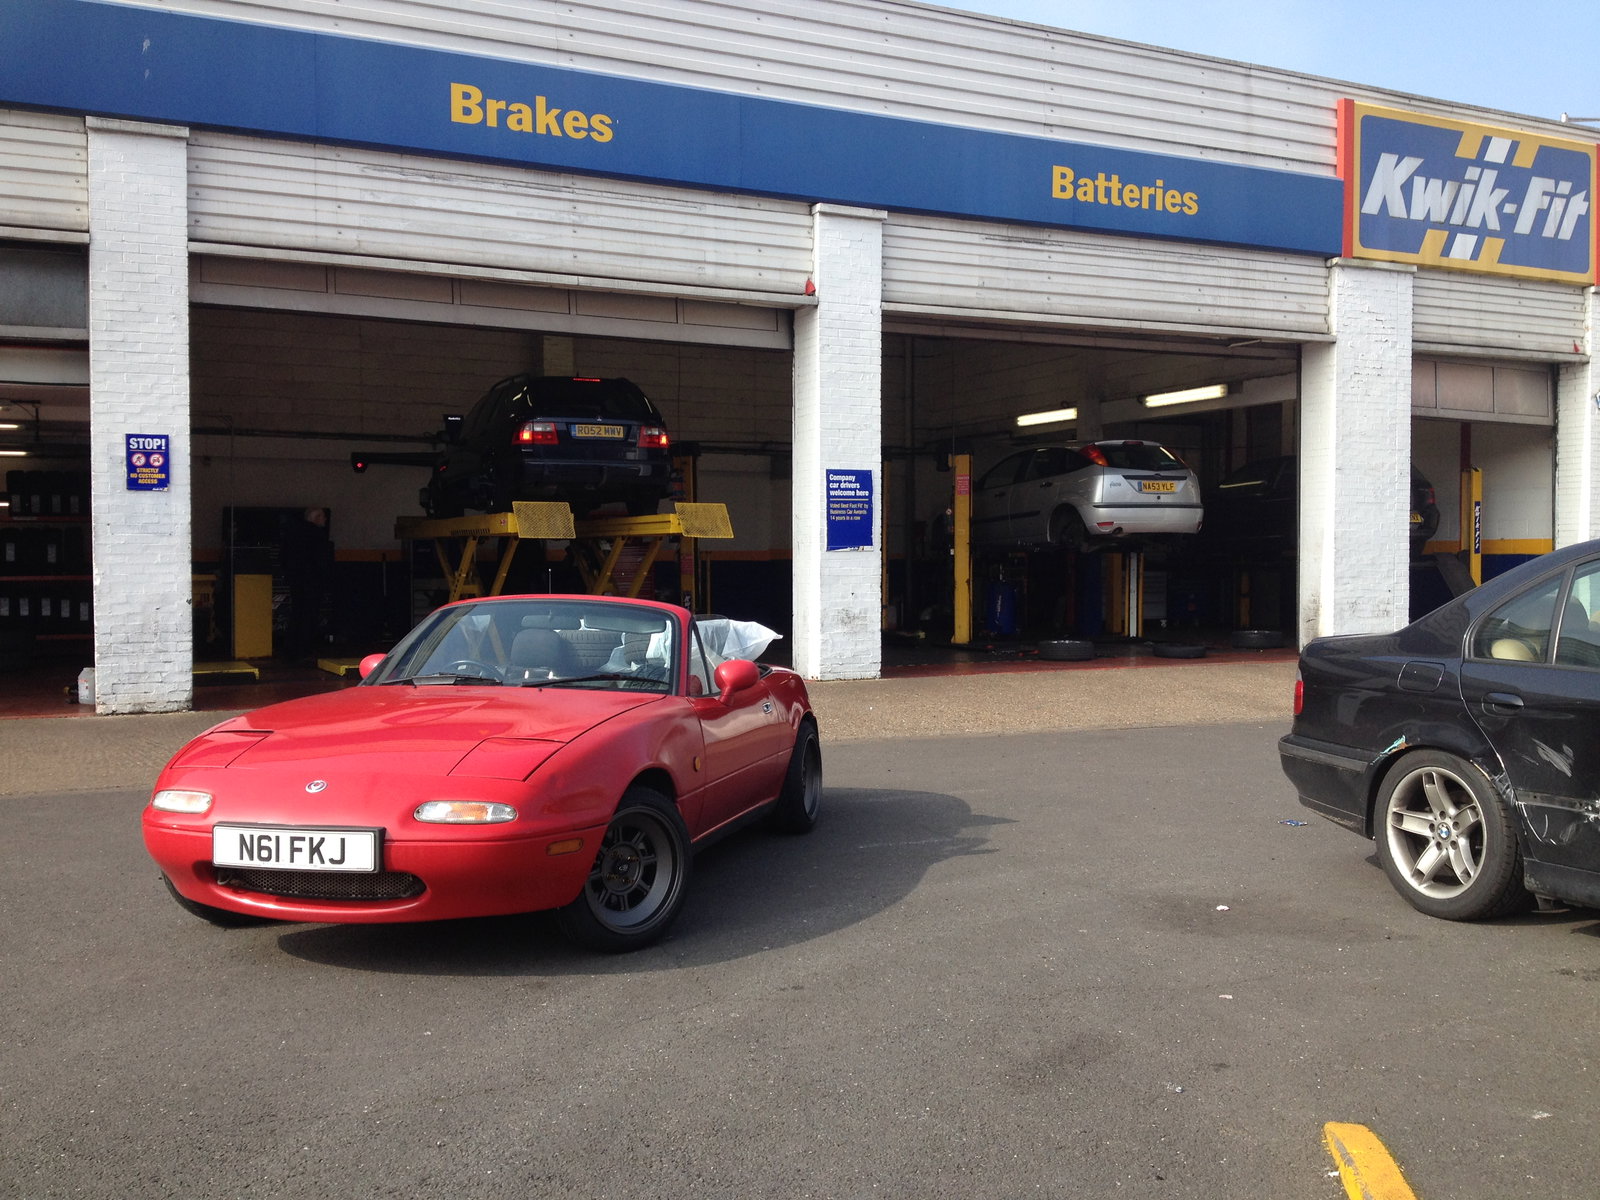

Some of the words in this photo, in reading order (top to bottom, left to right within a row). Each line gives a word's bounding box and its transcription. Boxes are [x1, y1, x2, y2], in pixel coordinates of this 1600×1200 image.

[451, 82, 613, 143] Brakes
[1052, 165, 1199, 216] Batteries
[1361, 152, 1590, 241] Kwik-Fit
[577, 426, 602, 435] RO52
[129, 437, 166, 450] STOP!
[829, 474, 856, 482] Company
[1143, 482, 1160, 490] NA53
[1162, 482, 1175, 490] YLF
[239, 833, 280, 862] N61
[289, 836, 346, 865] FKJ
